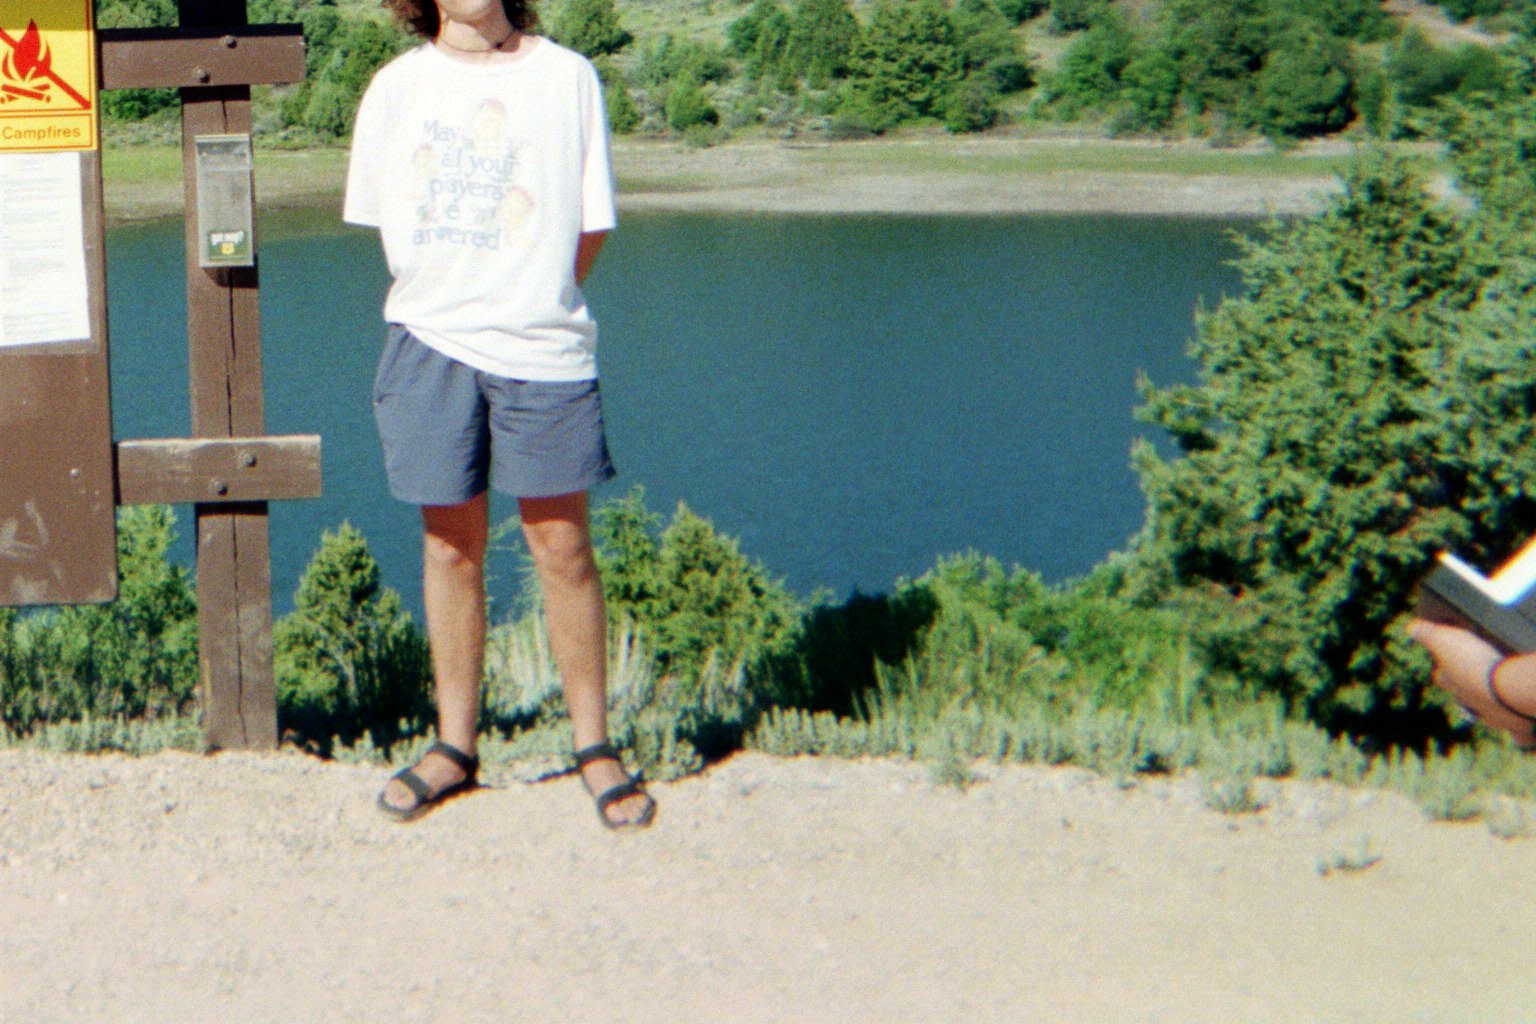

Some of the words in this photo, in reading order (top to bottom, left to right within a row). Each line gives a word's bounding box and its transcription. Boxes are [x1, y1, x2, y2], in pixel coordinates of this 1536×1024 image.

[2, 126, 81, 140] Campfires
[424, 119, 461, 147] May
[430, 178, 503, 202] payers
